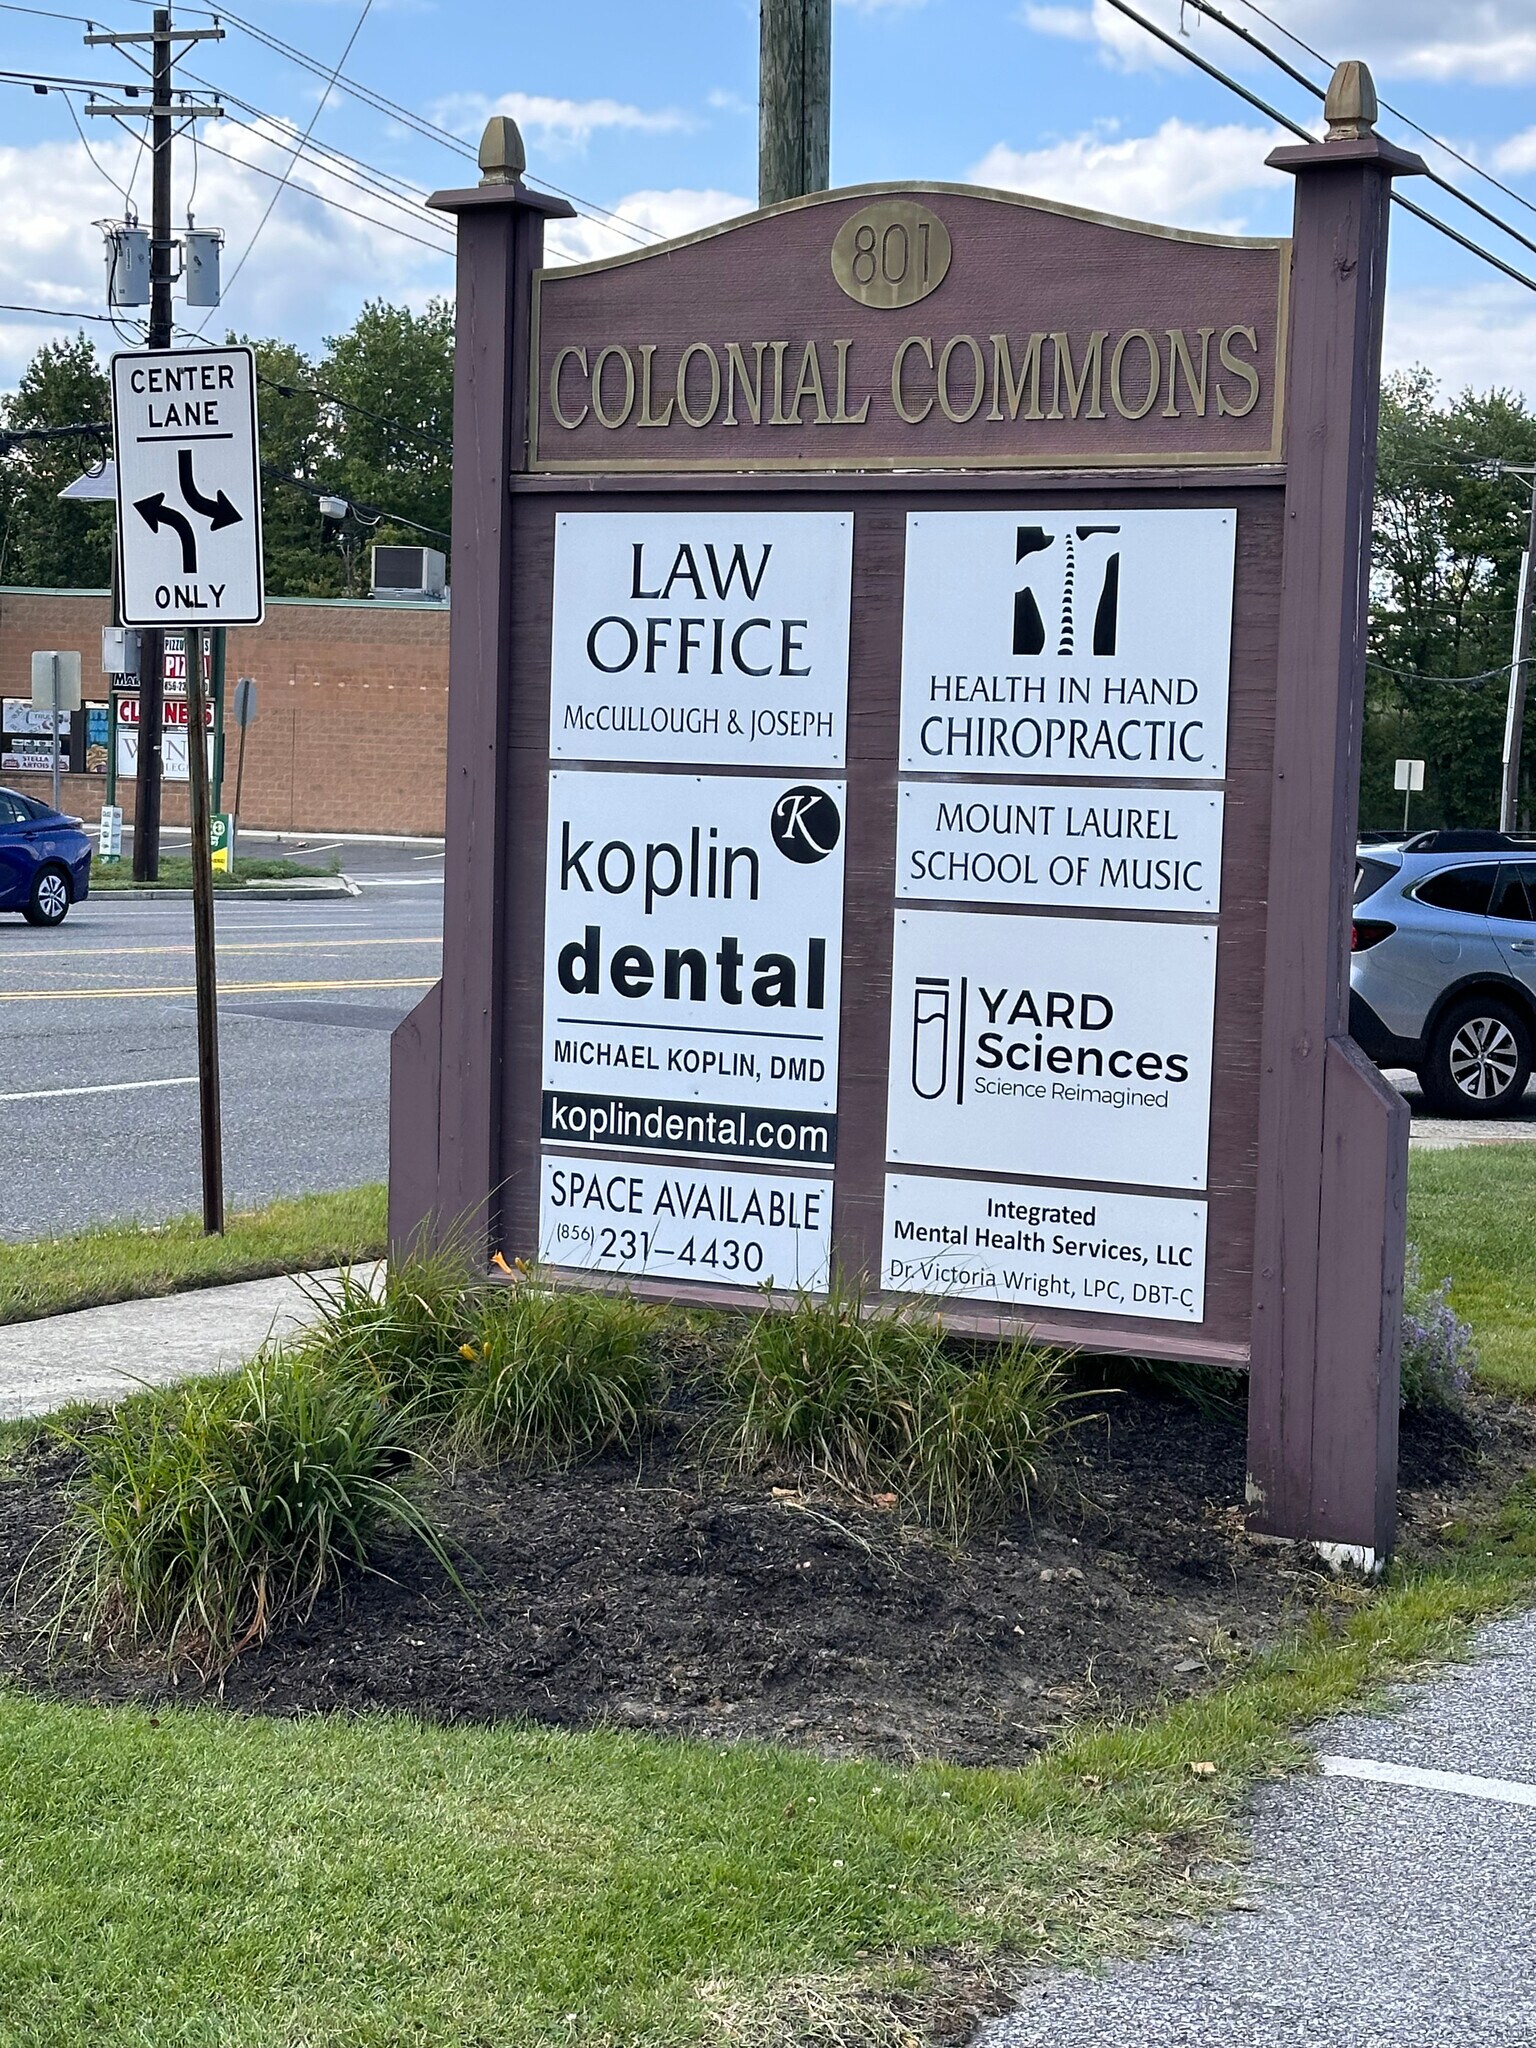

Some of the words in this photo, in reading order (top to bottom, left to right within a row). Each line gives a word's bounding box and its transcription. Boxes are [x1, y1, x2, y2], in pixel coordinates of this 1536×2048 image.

[852, 223, 931, 286] 801
[131, 365, 234, 393] CENTER
[550, 339, 871, 429] COLONIAL
[891, 325, 1260, 424] COMMONS
[149, 401, 218, 428] LANE
[630, 544, 772, 601] LAW
[155, 584, 225, 609] ONLY
[587, 616, 811, 676] OFFICE
[120, 700, 212, 725] CLNES
[930, 676, 1045, 702] HEALTH
[1059, 677, 1090, 704] IN
[1104, 678, 1198, 705] HAND
[564, 705, 718, 733] McCULLOUGH
[728, 709, 744, 734] &
[750, 710, 832, 742] JOSEPH
[921, 716, 1203, 762] CHIROPRACTIC
[777, 795, 833, 854] K
[936, 803, 1055, 835] MOUNT
[1067, 807, 1178, 839] LAUREL
[561, 821, 758, 914] koplin
[911, 851, 1038, 884] SCHOOL
[1049, 856, 1089, 886] OF
[1100, 858, 1202, 891] MUSIC
[558, 925, 825, 1009] dental
[979, 987, 1113, 1030] YARD
[555, 1040, 659, 1070] MICHAEL
[668, 1048, 760, 1082] KOPLIN,
[771, 1056, 824, 1081] DMD
[975, 1032, 1189, 1083] Sciences
[975, 1077, 1046, 1098] Science
[1052, 1082, 1169, 1109] Reimagined
[551, 1097, 828, 1152] koplindental.com
[551, 1171, 643, 1213] SPACE
[653, 1179, 820, 1231] AVAILABLE
[988, 1198, 1095, 1226] Integrated
[557, 1223, 594, 1246] (856)
[895, 1220, 967, 1245] Mental
[976, 1228, 1044, 1253] Health
[1053, 1235, 1148, 1266] Services,
[1157, 1245, 1192, 1266] LLC
[890, 1259, 915, 1279] Dr.
[920, 1261, 996, 1287] Victoria
[1003, 1271, 1075, 1298] Wright,
[1084, 1279, 1124, 1303] LPC,
[1134, 1284, 1192, 1306] DBT-C
